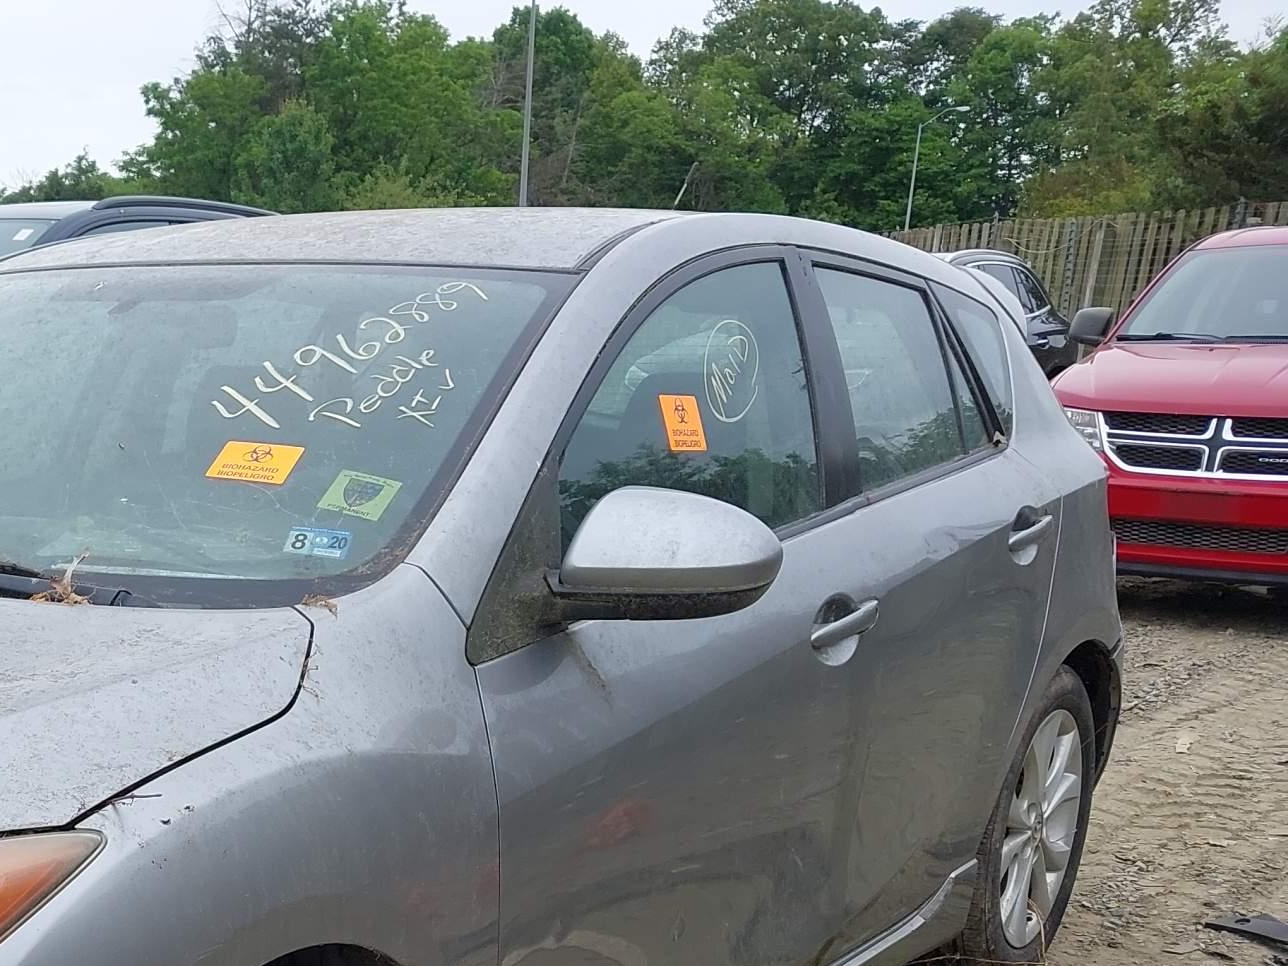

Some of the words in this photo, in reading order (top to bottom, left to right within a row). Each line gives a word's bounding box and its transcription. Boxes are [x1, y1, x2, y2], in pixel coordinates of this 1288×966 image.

[210, 281, 489, 429] 44962889
[291, 533, 308, 550] 8
[328, 536, 348, 550] 20
